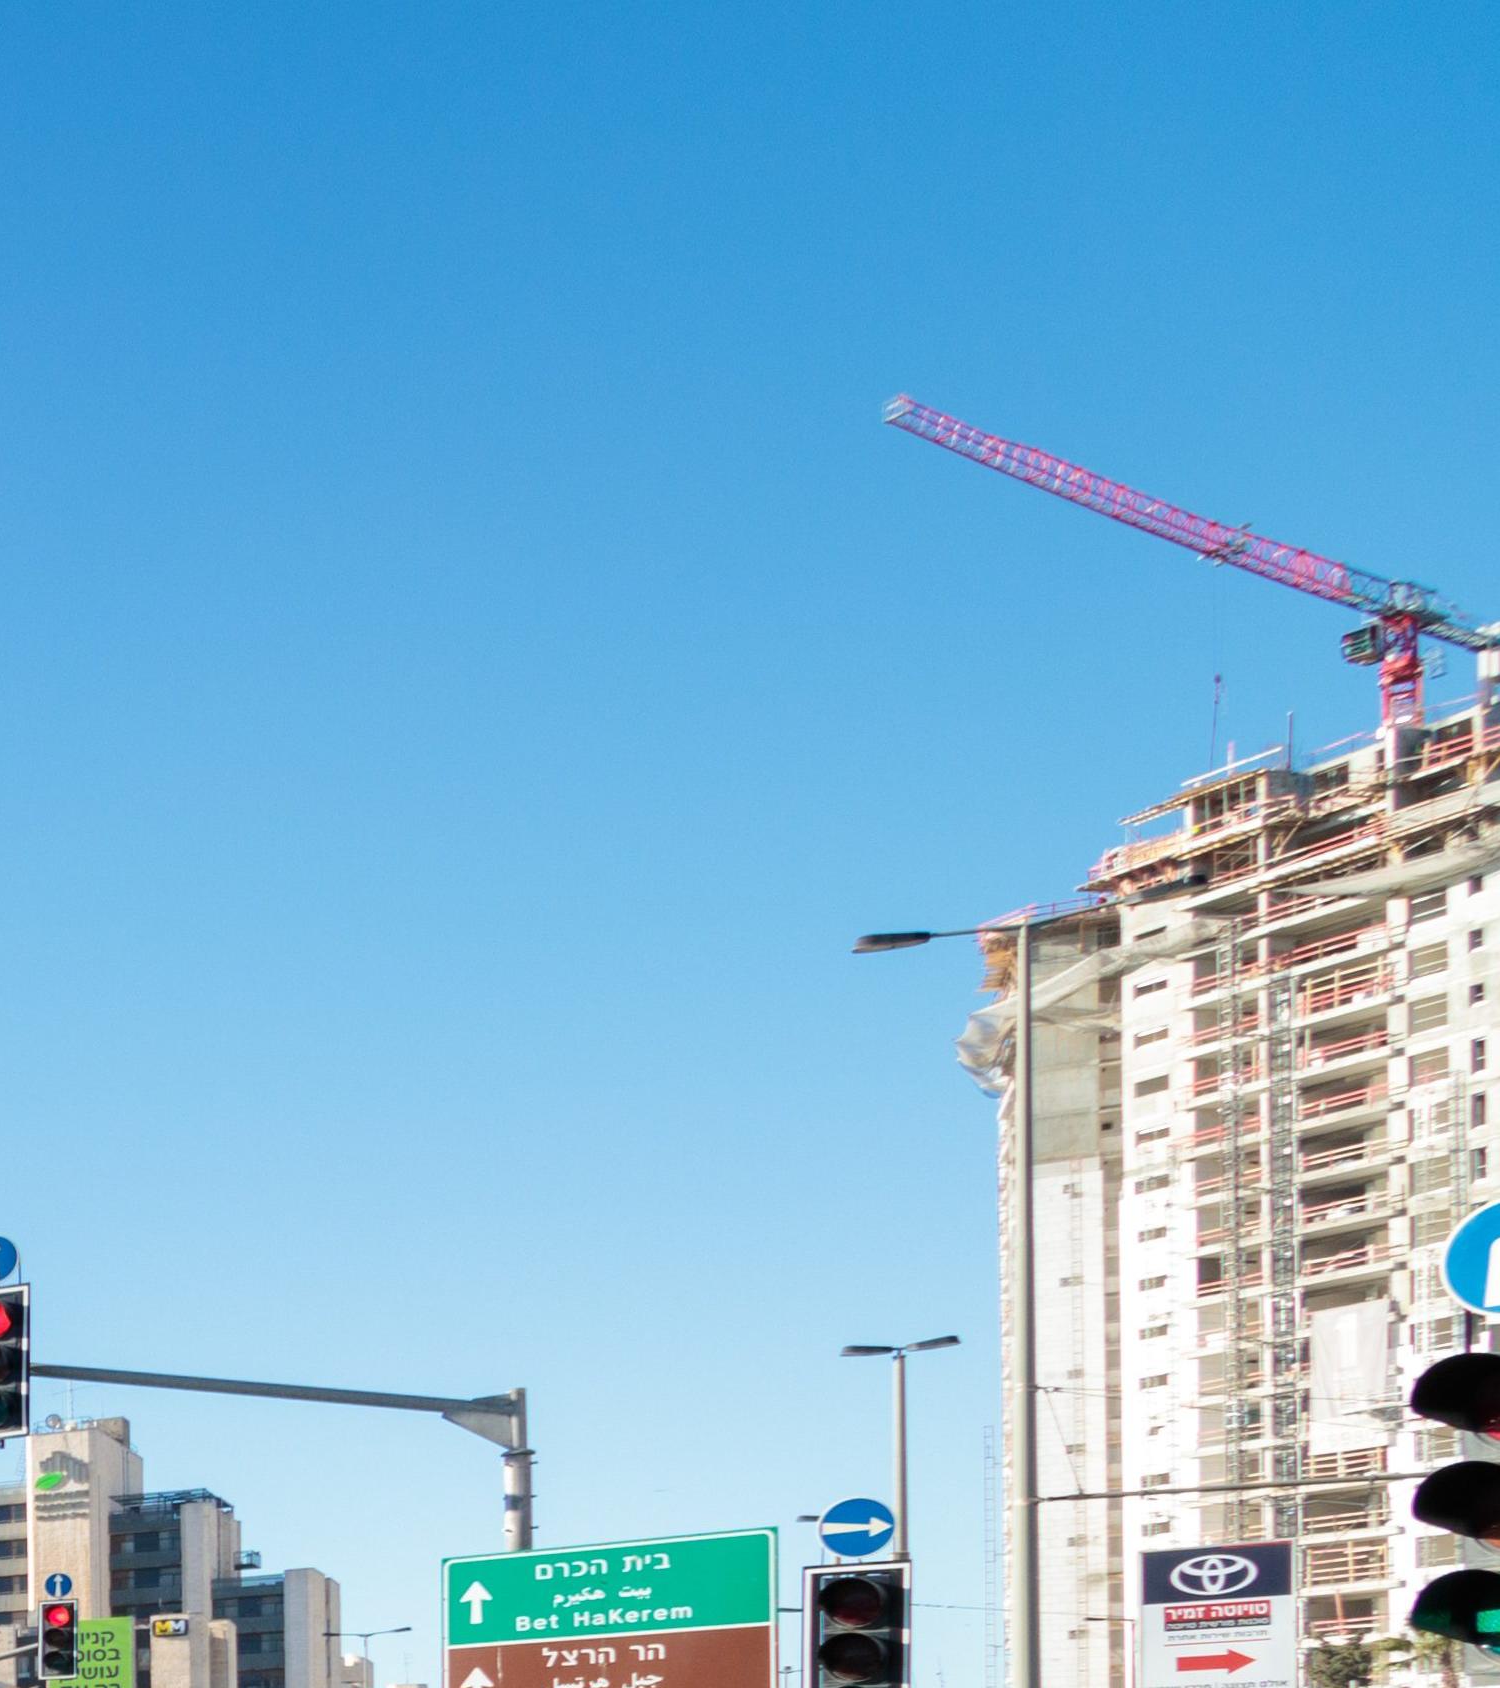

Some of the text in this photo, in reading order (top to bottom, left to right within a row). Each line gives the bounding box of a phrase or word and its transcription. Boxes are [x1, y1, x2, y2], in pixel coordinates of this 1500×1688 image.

[534, 1552, 672, 1581] בית הכרם
[552, 1585, 653, 1608] بيت هكيرم
[515, 1605, 694, 1632] Bet HaKerem
[1165, 1602, 1269, 1620] טויוטה זמיר
[80, 1630, 115, 1647] קניו
[541, 1643, 667, 1668] הר הרצל
